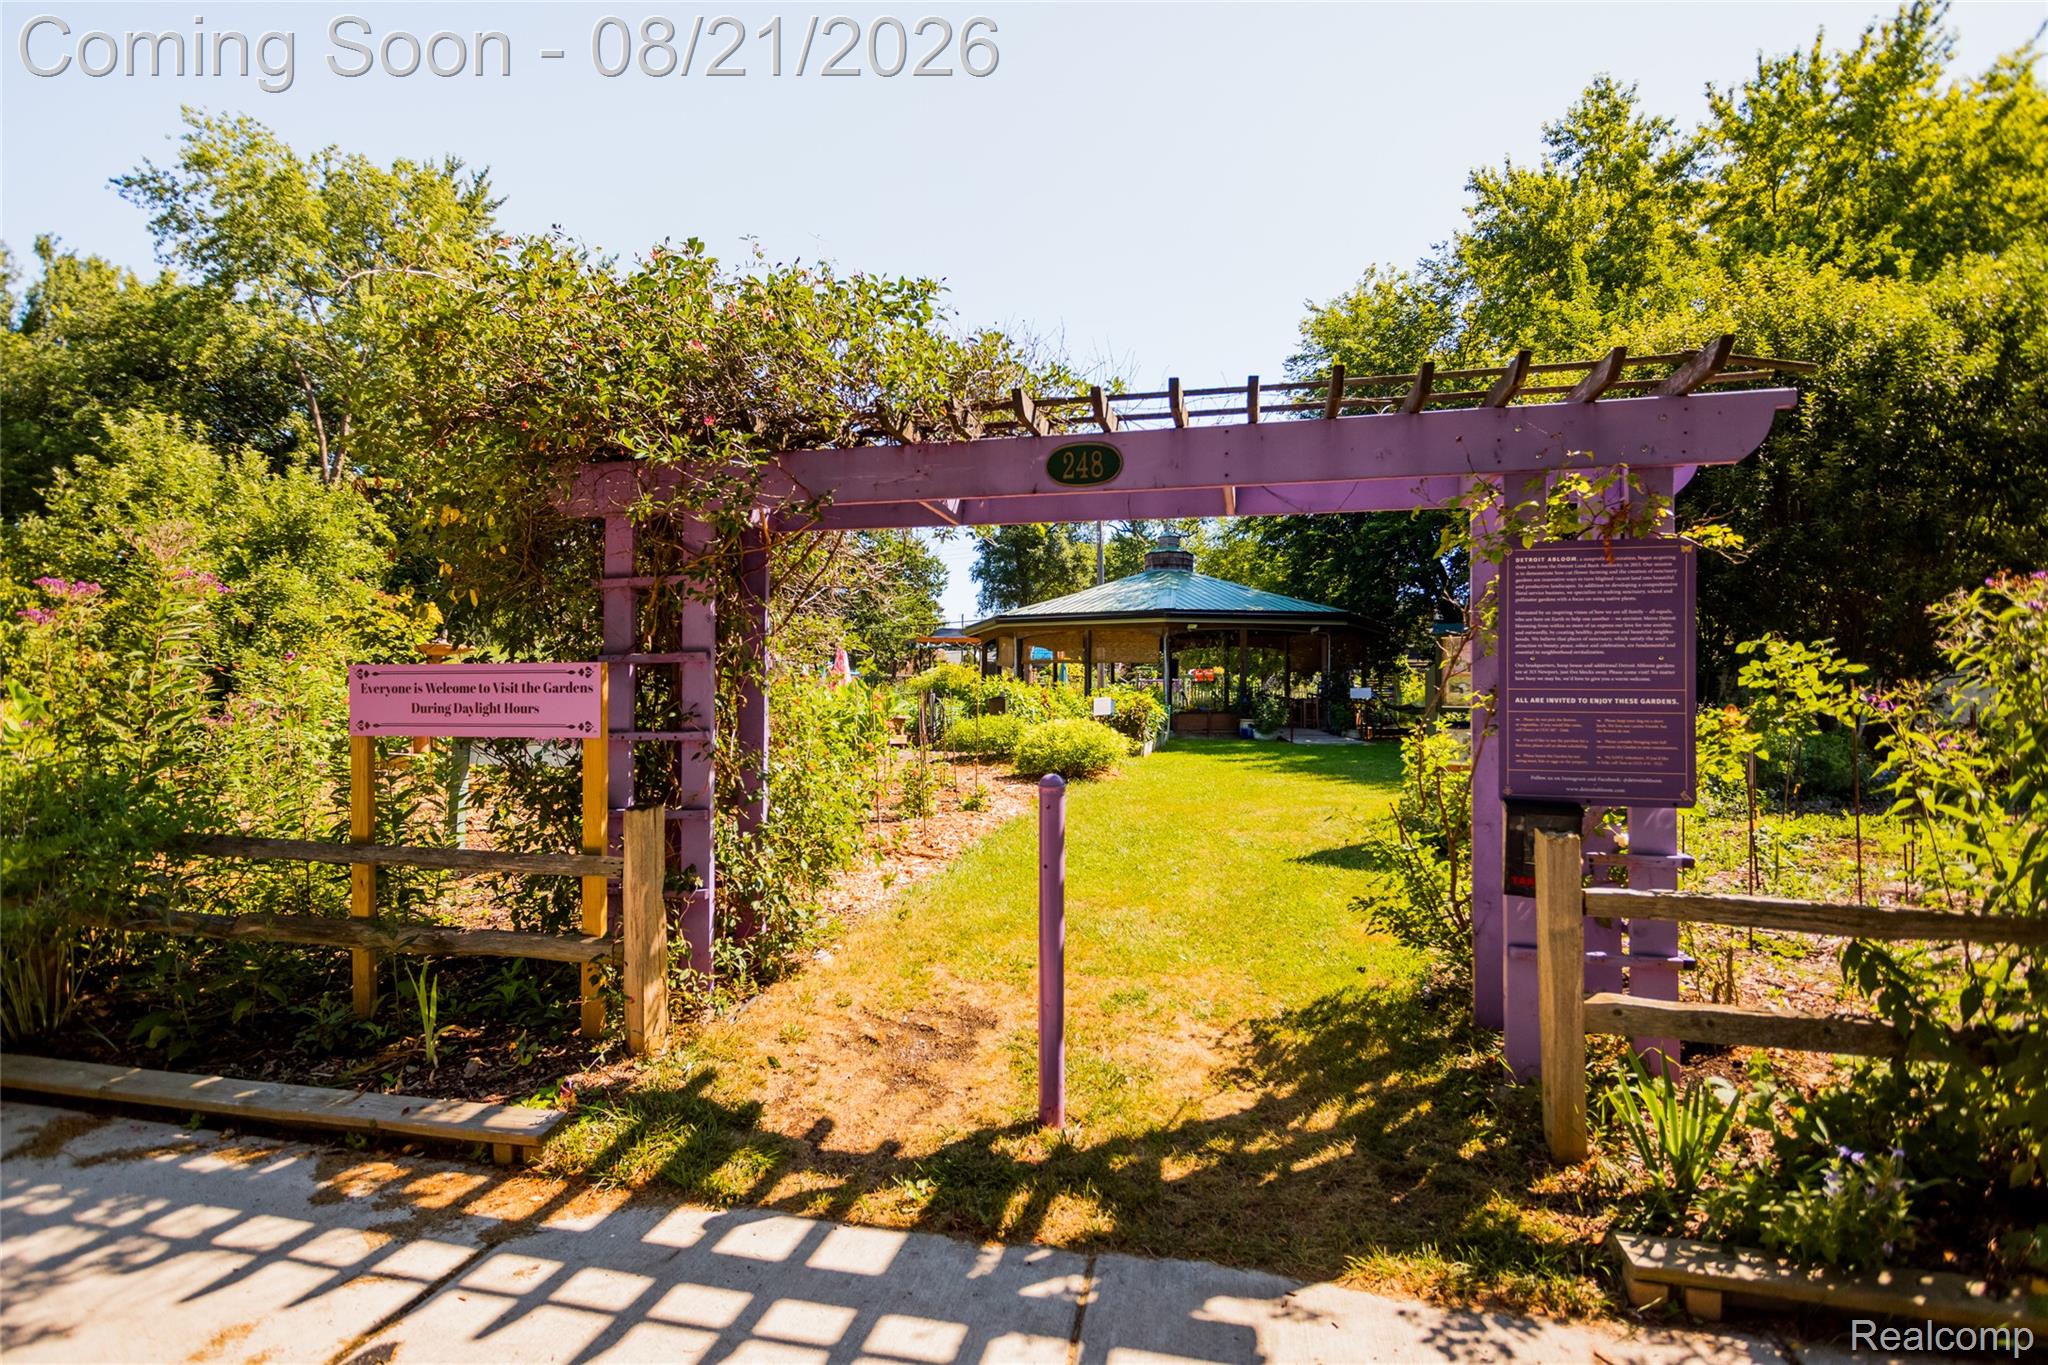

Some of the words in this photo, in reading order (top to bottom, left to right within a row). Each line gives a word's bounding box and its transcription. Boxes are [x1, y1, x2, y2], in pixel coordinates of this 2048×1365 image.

[1062, 450, 1105, 480] 248
[361, 682, 411, 697] Everyone
[414, 682, 423, 694] is
[425, 681, 476, 694] Welcome
[479, 682, 490, 694] to
[492, 682, 518, 694] Visit
[521, 681, 540, 694] the
[543, 681, 594, 694] Gardens
[411, 702, 451, 717] During
[453, 701, 500, 717] Daylight
[503, 702, 540, 714] Hours
